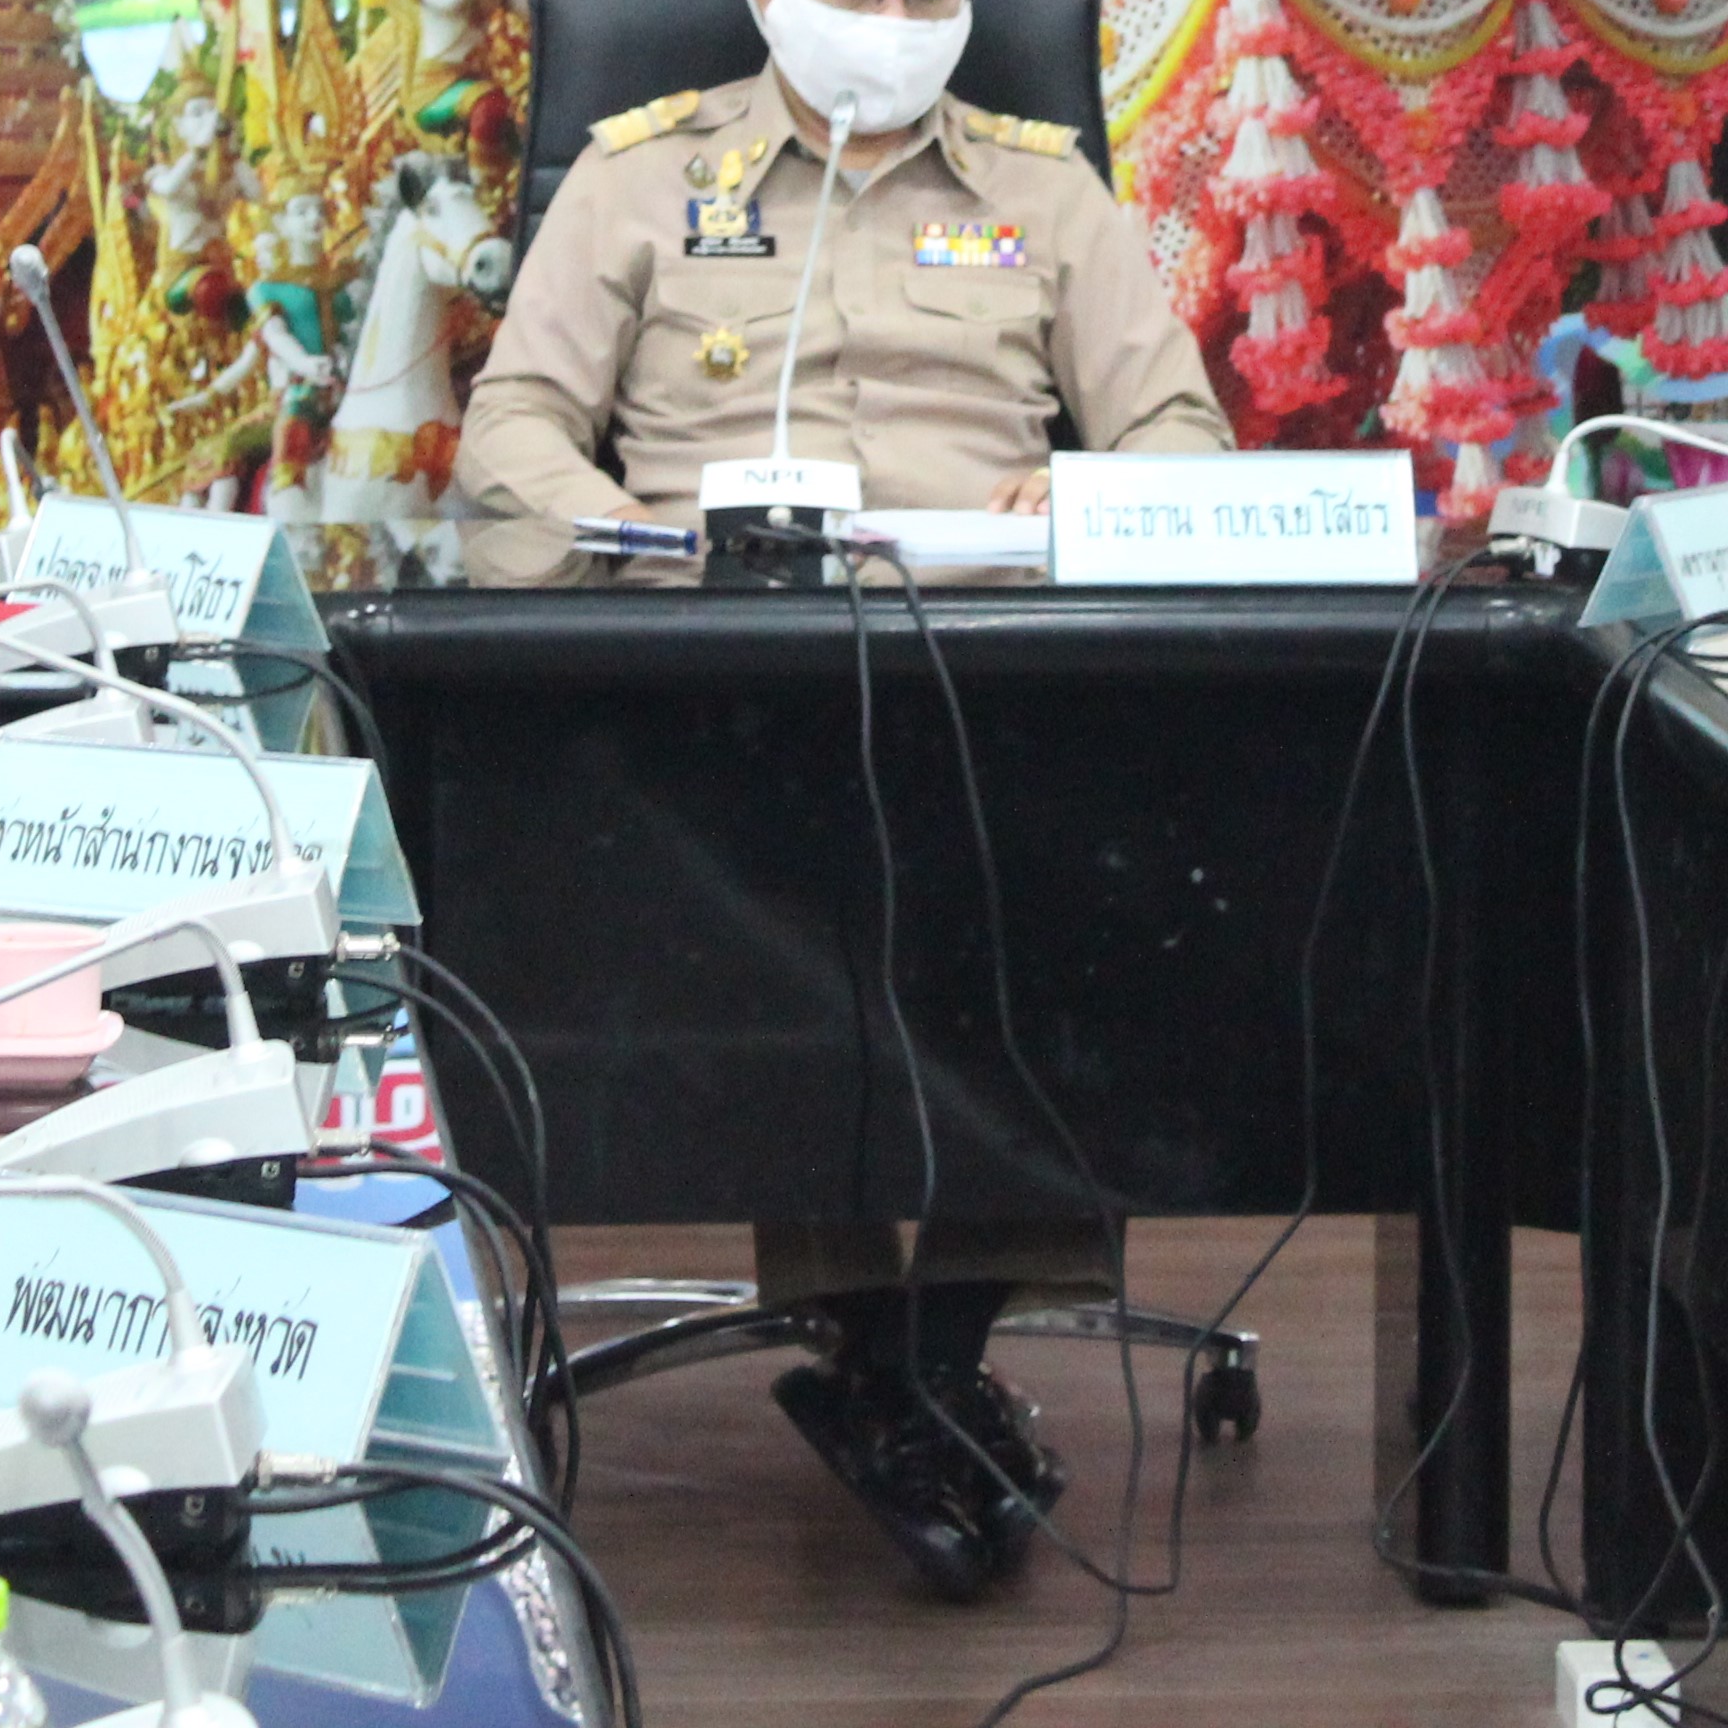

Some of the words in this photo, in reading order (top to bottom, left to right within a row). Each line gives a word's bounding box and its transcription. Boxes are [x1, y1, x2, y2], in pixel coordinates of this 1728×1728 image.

[1083, 489, 1195, 539] ประธาน
[3, 1246, 319, 1382] พัฒนากาจังหวัด
